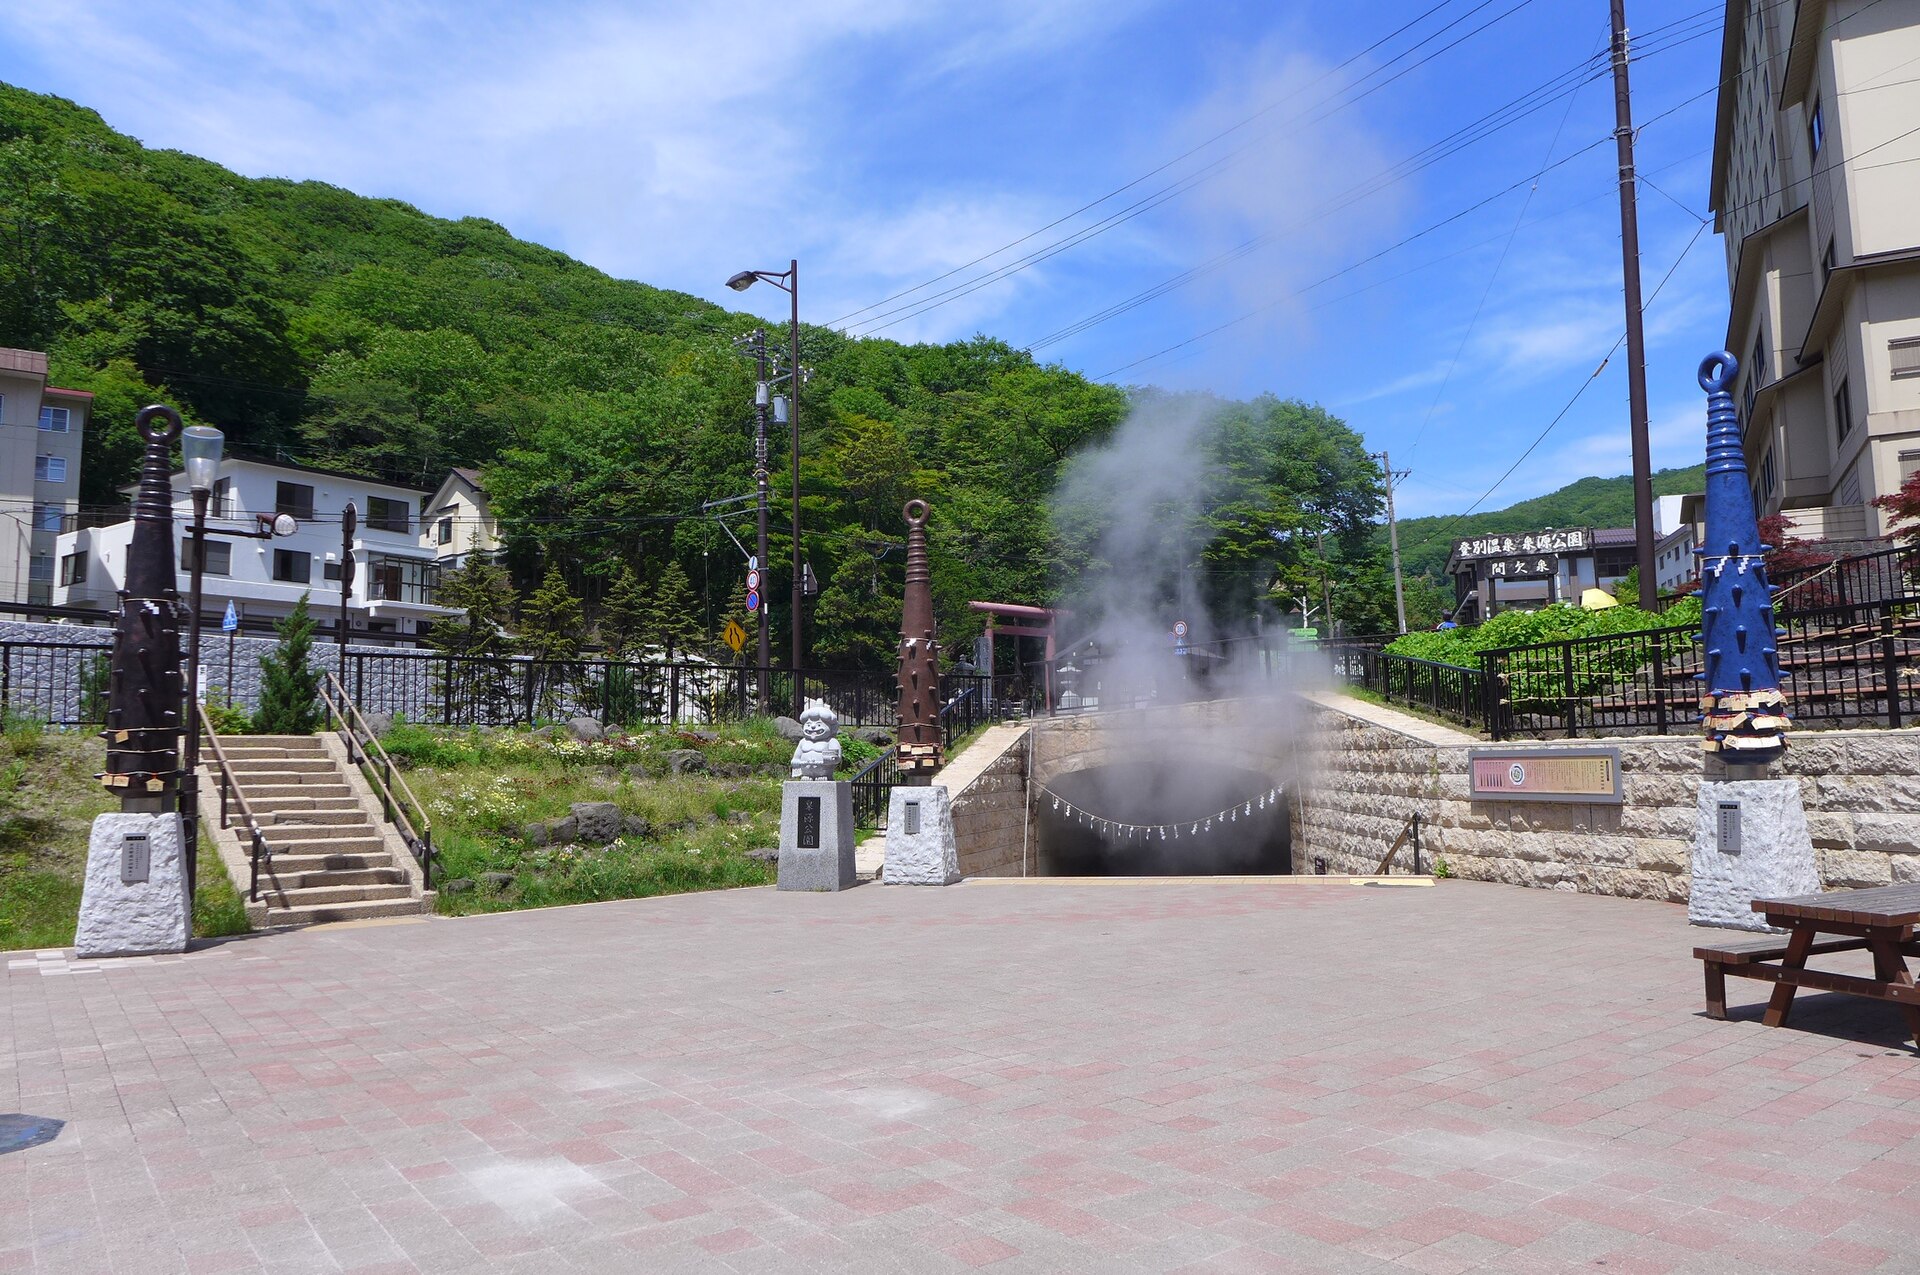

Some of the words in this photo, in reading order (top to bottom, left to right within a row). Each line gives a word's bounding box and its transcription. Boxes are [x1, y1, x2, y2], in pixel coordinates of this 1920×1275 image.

[1458, 538, 1516, 556] 登別温泉
[1522, 531, 1583, 550] 泉源公園
[1491, 558, 1550, 576] 間欠泉
